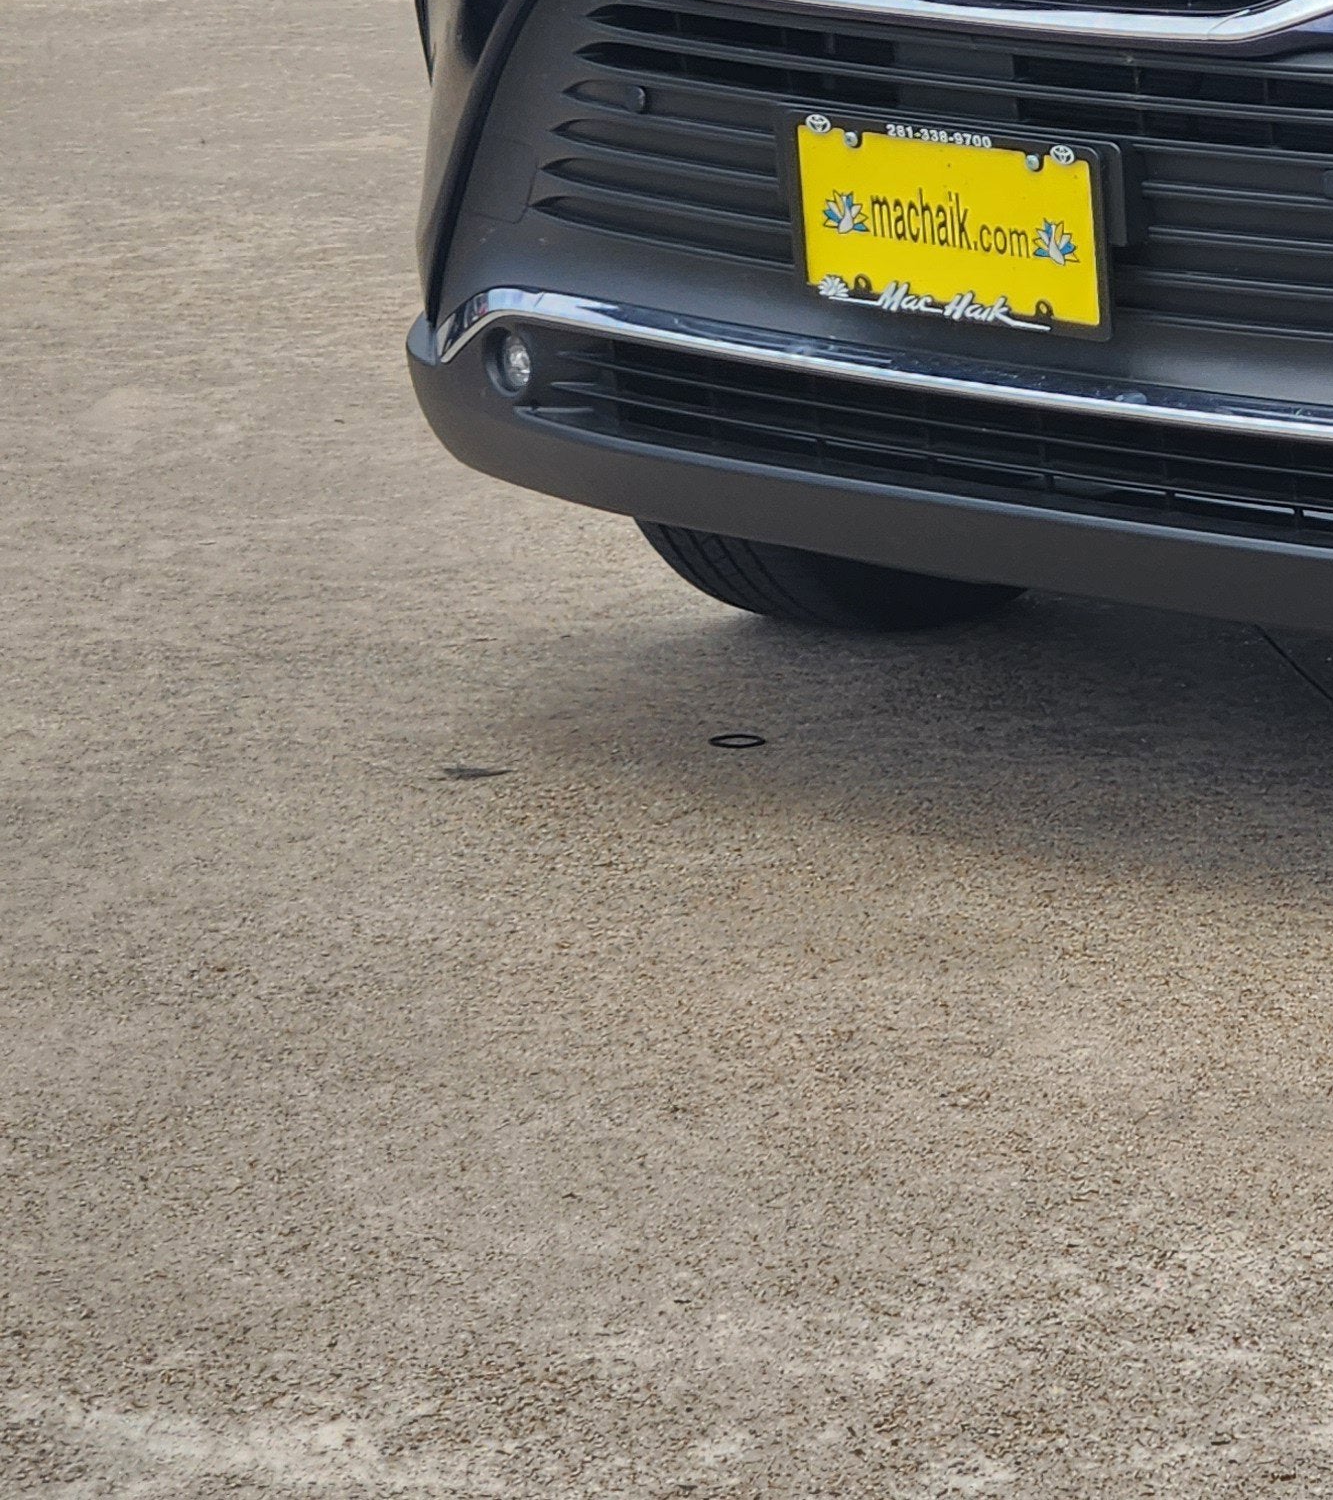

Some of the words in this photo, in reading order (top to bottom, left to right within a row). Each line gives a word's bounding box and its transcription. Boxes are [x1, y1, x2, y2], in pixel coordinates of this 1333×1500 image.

[885, 123, 992, 149] 281-338-9700
[870, 187, 1031, 259] machaik.com
[877, 281, 938, 313] Mac
[942, 291, 1012, 323] Haik
